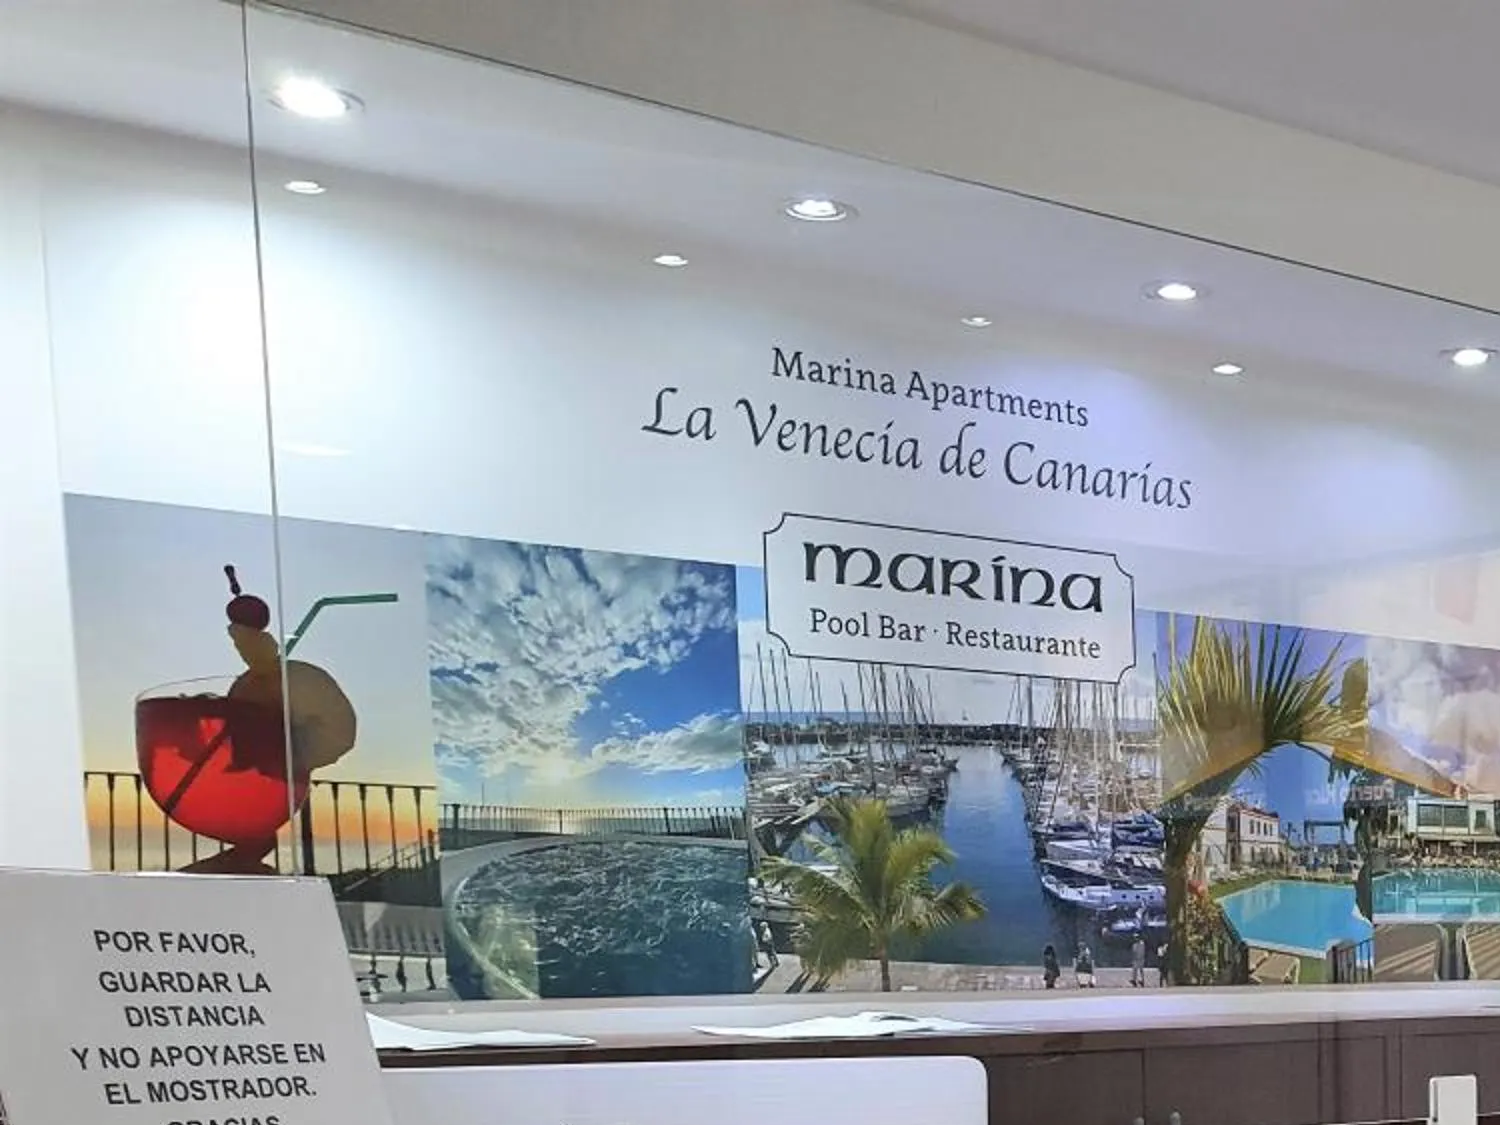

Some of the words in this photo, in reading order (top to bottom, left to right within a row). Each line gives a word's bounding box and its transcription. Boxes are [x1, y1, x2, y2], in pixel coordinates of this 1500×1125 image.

[772, 347, 897, 395] Marina
[904, 370, 1089, 427] Apartments
[641, 387, 717, 441] La
[939, 421, 986, 479] de
[810, 607, 870, 638] Pool
[878, 614, 926, 643] Bar
[945, 621, 1100, 659] Restaurante
[93, 929, 154, 953] POR
[158, 931, 255, 955] FAVOR,
[98, 970, 233, 993] GUARDAR
[236, 972, 272, 993] LA
[124, 1005, 265, 1028] DISTANCIA
[71, 1047, 89, 1070] Y
[98, 1046, 141, 1069] NO
[149, 1043, 289, 1068] APOYARSE
[293, 1043, 326, 1064] EN
[103, 1082, 142, 1105] EL
[146, 1075, 317, 1103] MOSTRADOR.
